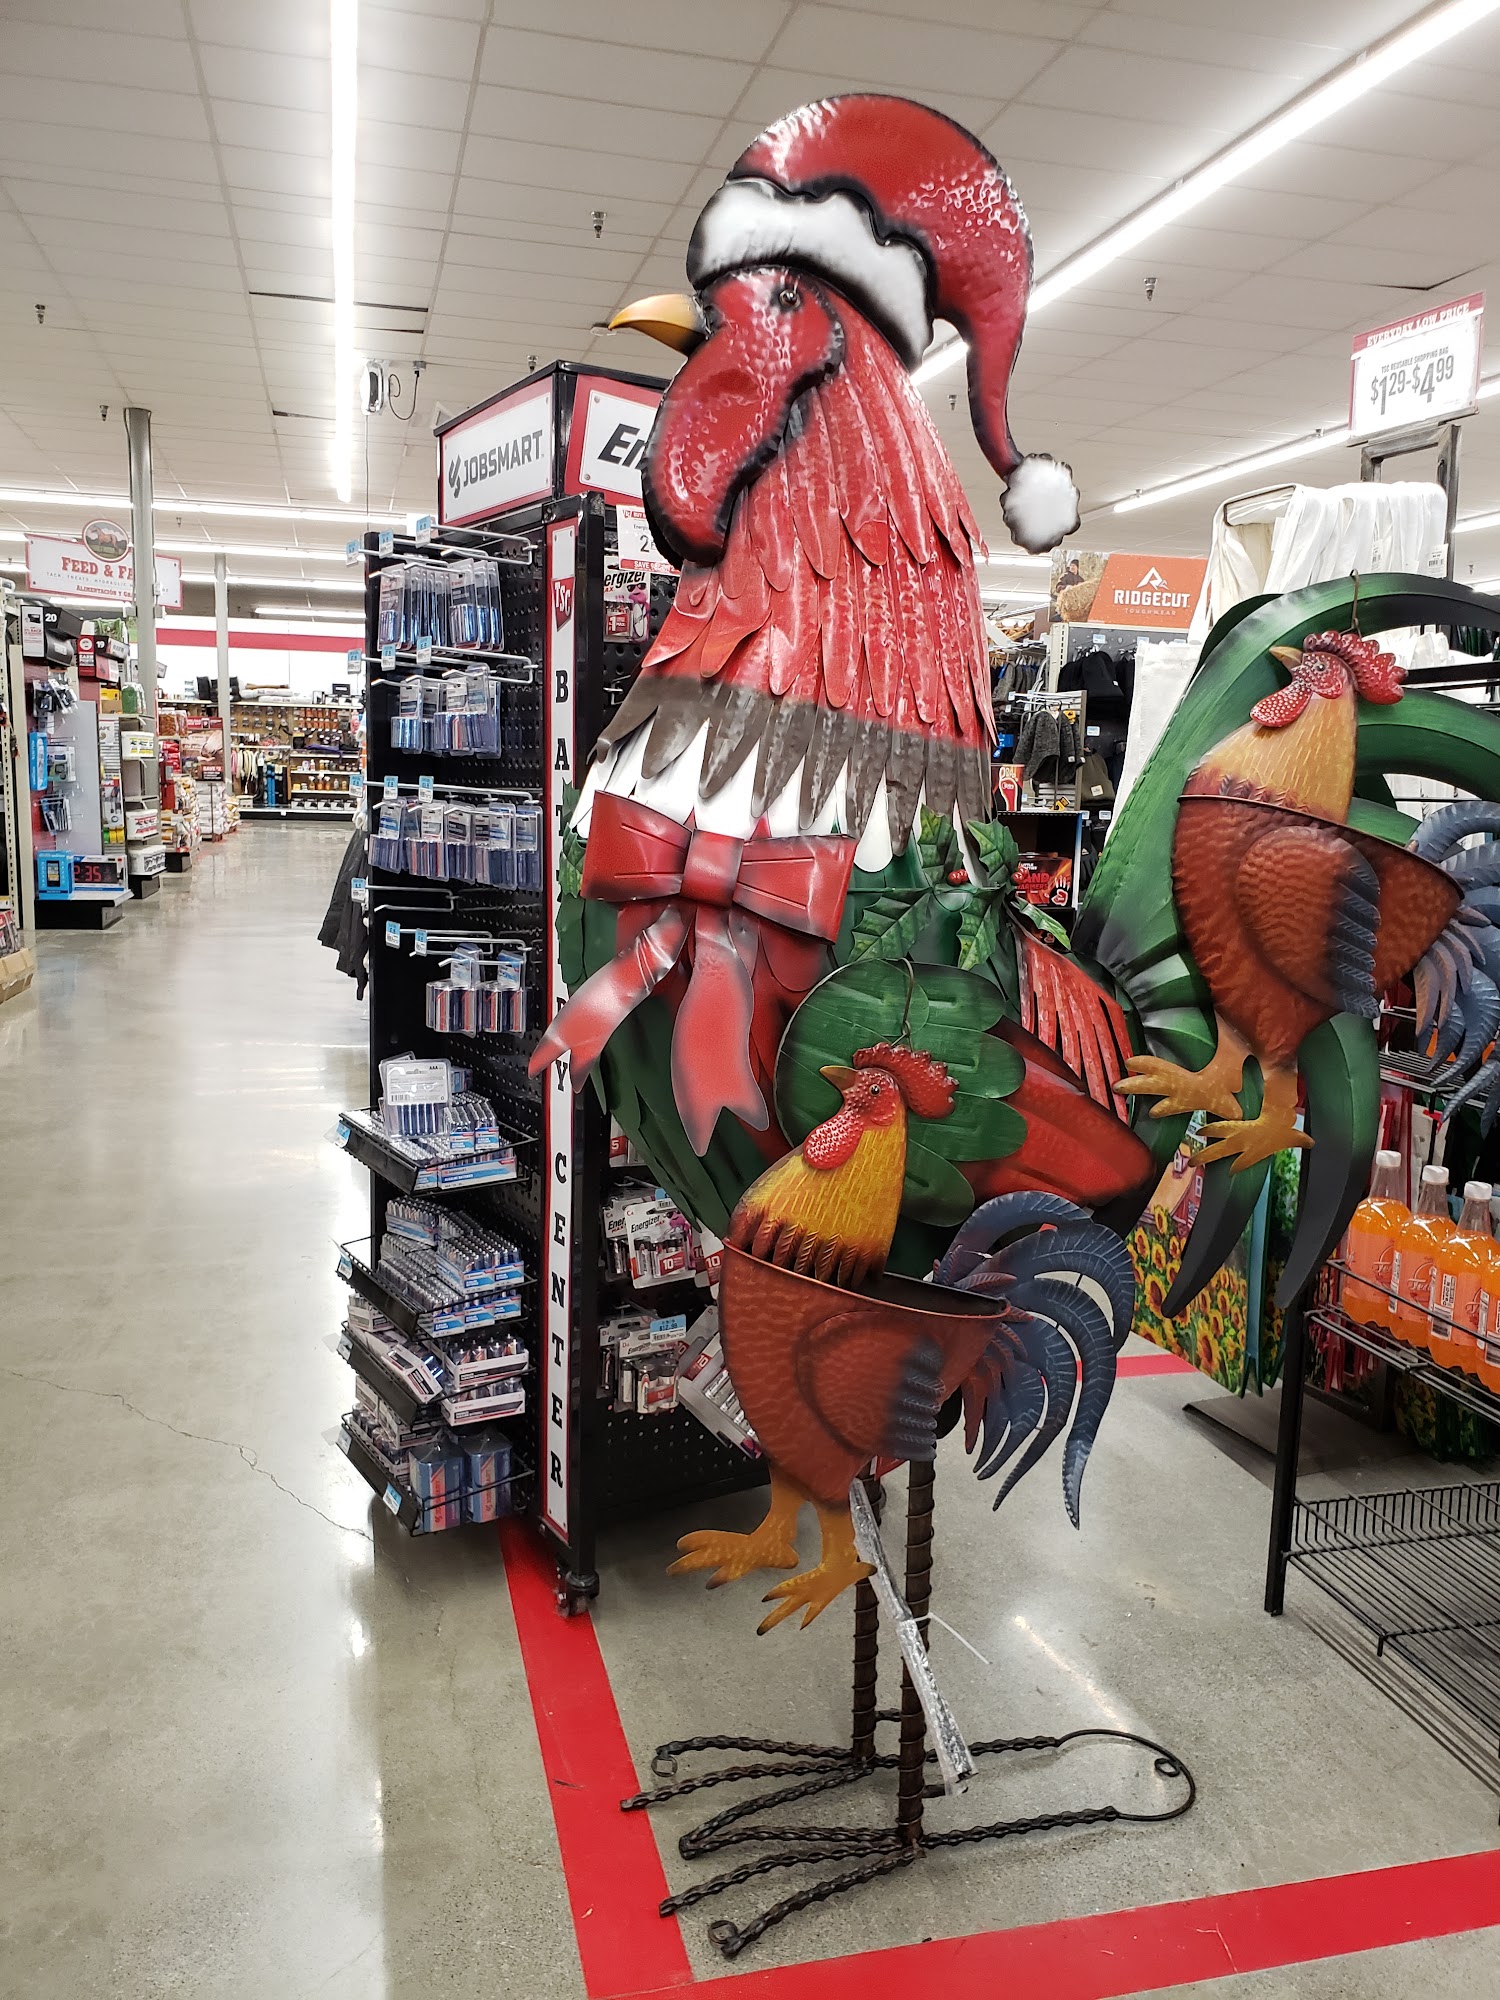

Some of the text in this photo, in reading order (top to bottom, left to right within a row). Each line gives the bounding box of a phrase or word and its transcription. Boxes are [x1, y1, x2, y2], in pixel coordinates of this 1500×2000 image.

[1366, 302, 1470, 346] EVERYDAY LOW PRICE
[1390, 357, 1413, 371] REUSABLE
[1414, 349, 1438, 364] SHOPPING
[598, 423, 649, 473] En
[463, 429, 544, 488] JOBSMART
[640, 535, 650, 553] 2
[61, 556, 99, 575] FEED
[103, 564, 113, 577] &
[555, 582, 571, 615] TSC
[1113, 589, 1190, 608] RIDGECUT
[45, 613, 57, 622] 20
[1124, 608, 1176, 617] TOUGHWEAR
[95, 641, 105, 649] 19
[1024, 872, 1050, 883] AND
[611, 1140, 619, 1150] 5
[608, 1217, 626, 1231] Ener
[630, 1215, 660, 1233] Energizer
[663, 1258, 674, 1270] 10
[705, 1255, 720, 1268] 10
[550, 1152, 567, 1489] CENTER
[697, 1355, 709, 1368] 10
